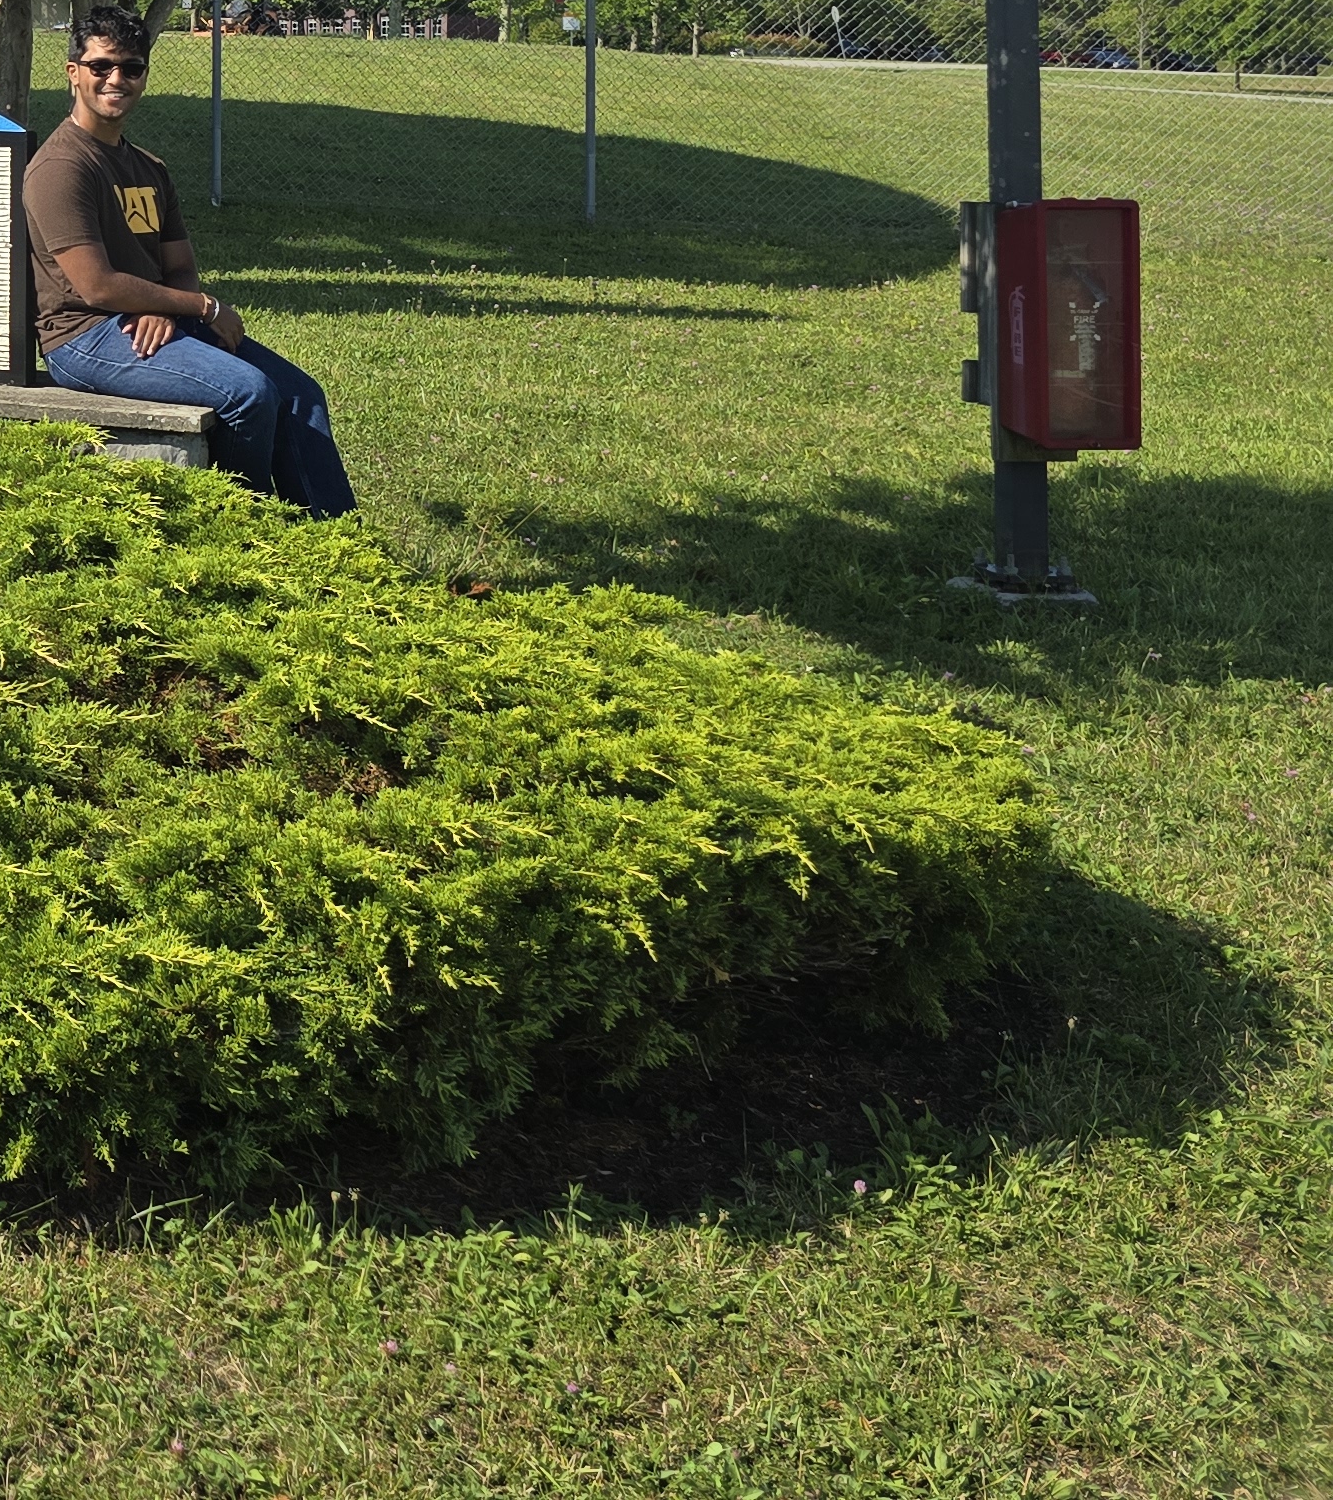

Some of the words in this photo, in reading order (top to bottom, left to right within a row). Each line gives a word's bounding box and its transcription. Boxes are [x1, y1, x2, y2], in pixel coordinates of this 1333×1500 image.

[113, 185, 160, 233] AT
[1013, 306, 1023, 357] FIRE
[1073, 315, 1096, 324] FIRE
